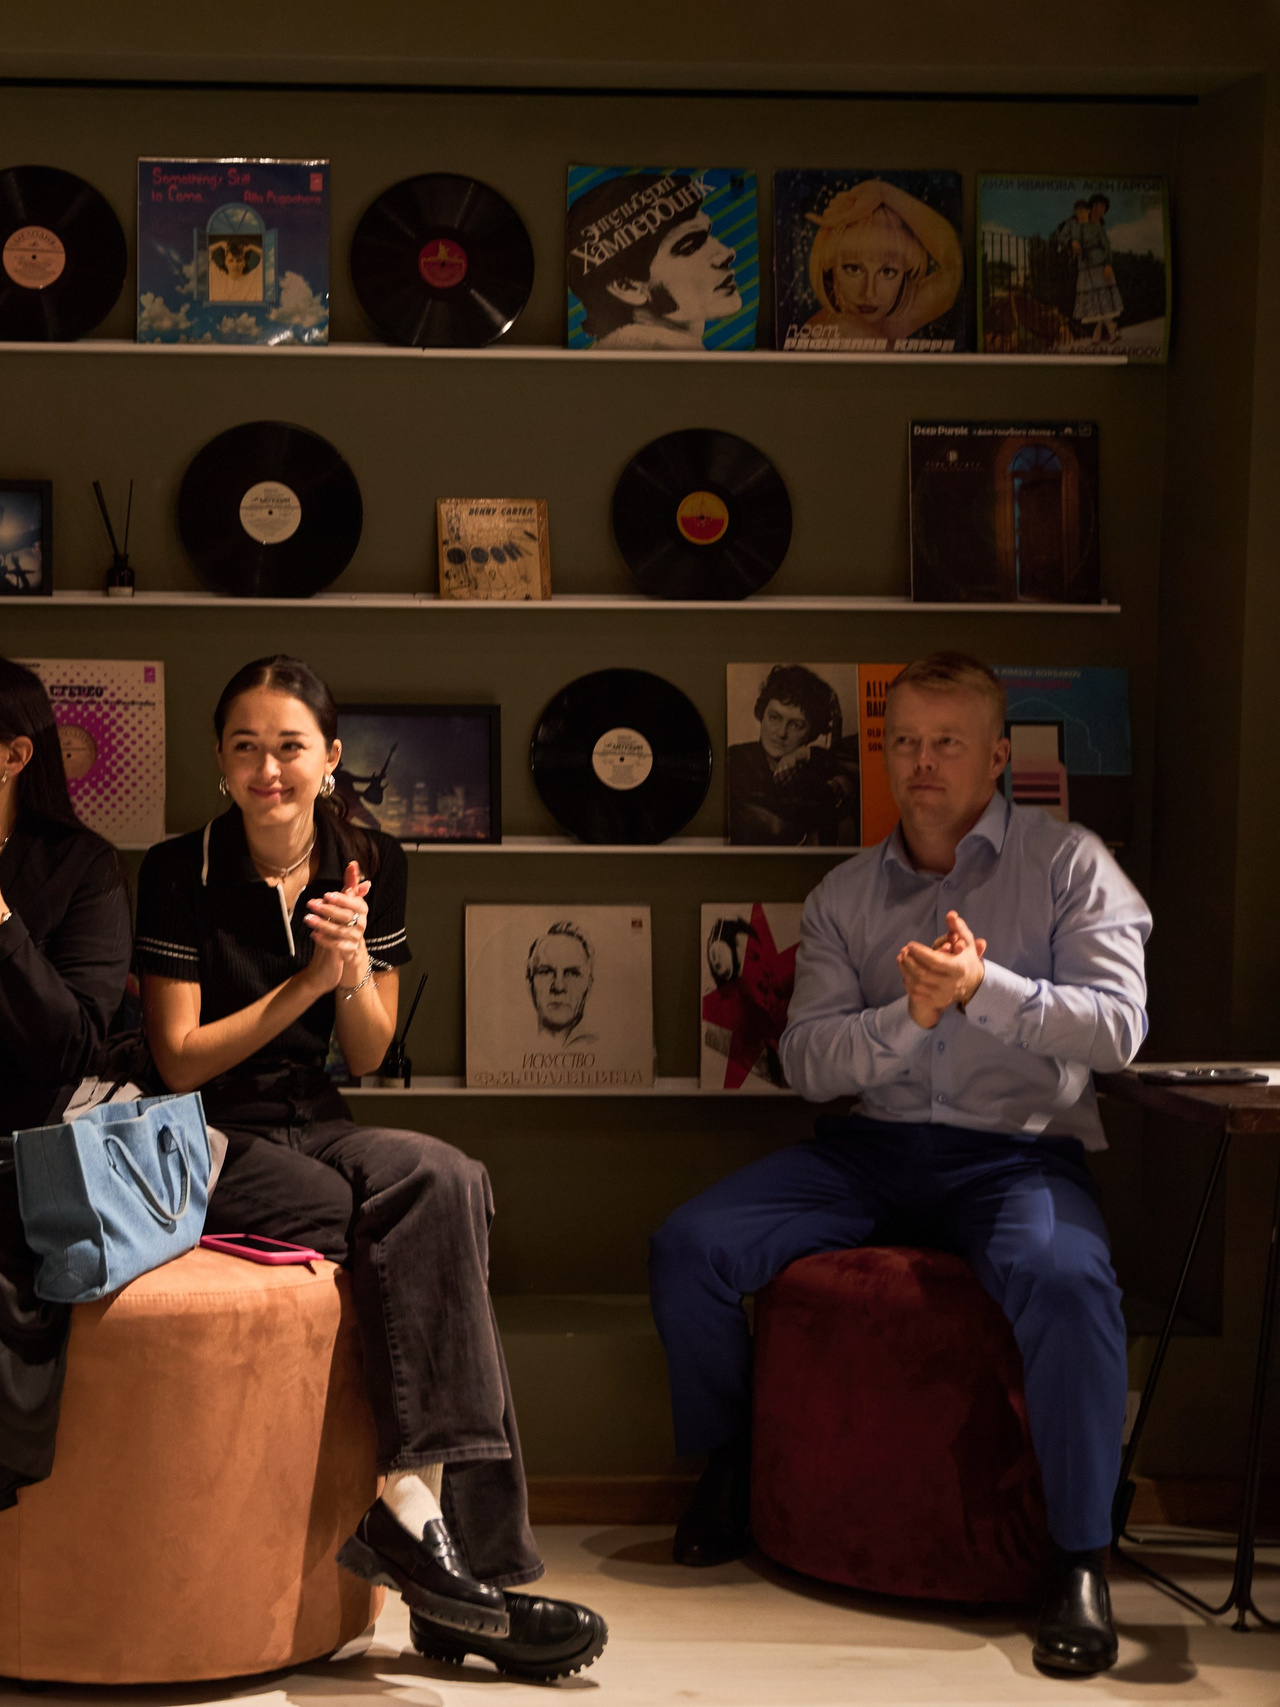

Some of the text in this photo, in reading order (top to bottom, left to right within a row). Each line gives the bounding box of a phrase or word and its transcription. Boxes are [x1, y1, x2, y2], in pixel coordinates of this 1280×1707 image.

[913, 425, 938, 436] Deep
[937, 425, 969, 437] Purple
[468, 507, 534, 516] BENNY CARTER
[49, 685, 104, 698] СТЕРЕО
[522, 1052, 596, 1069] ИСКУССТВО
